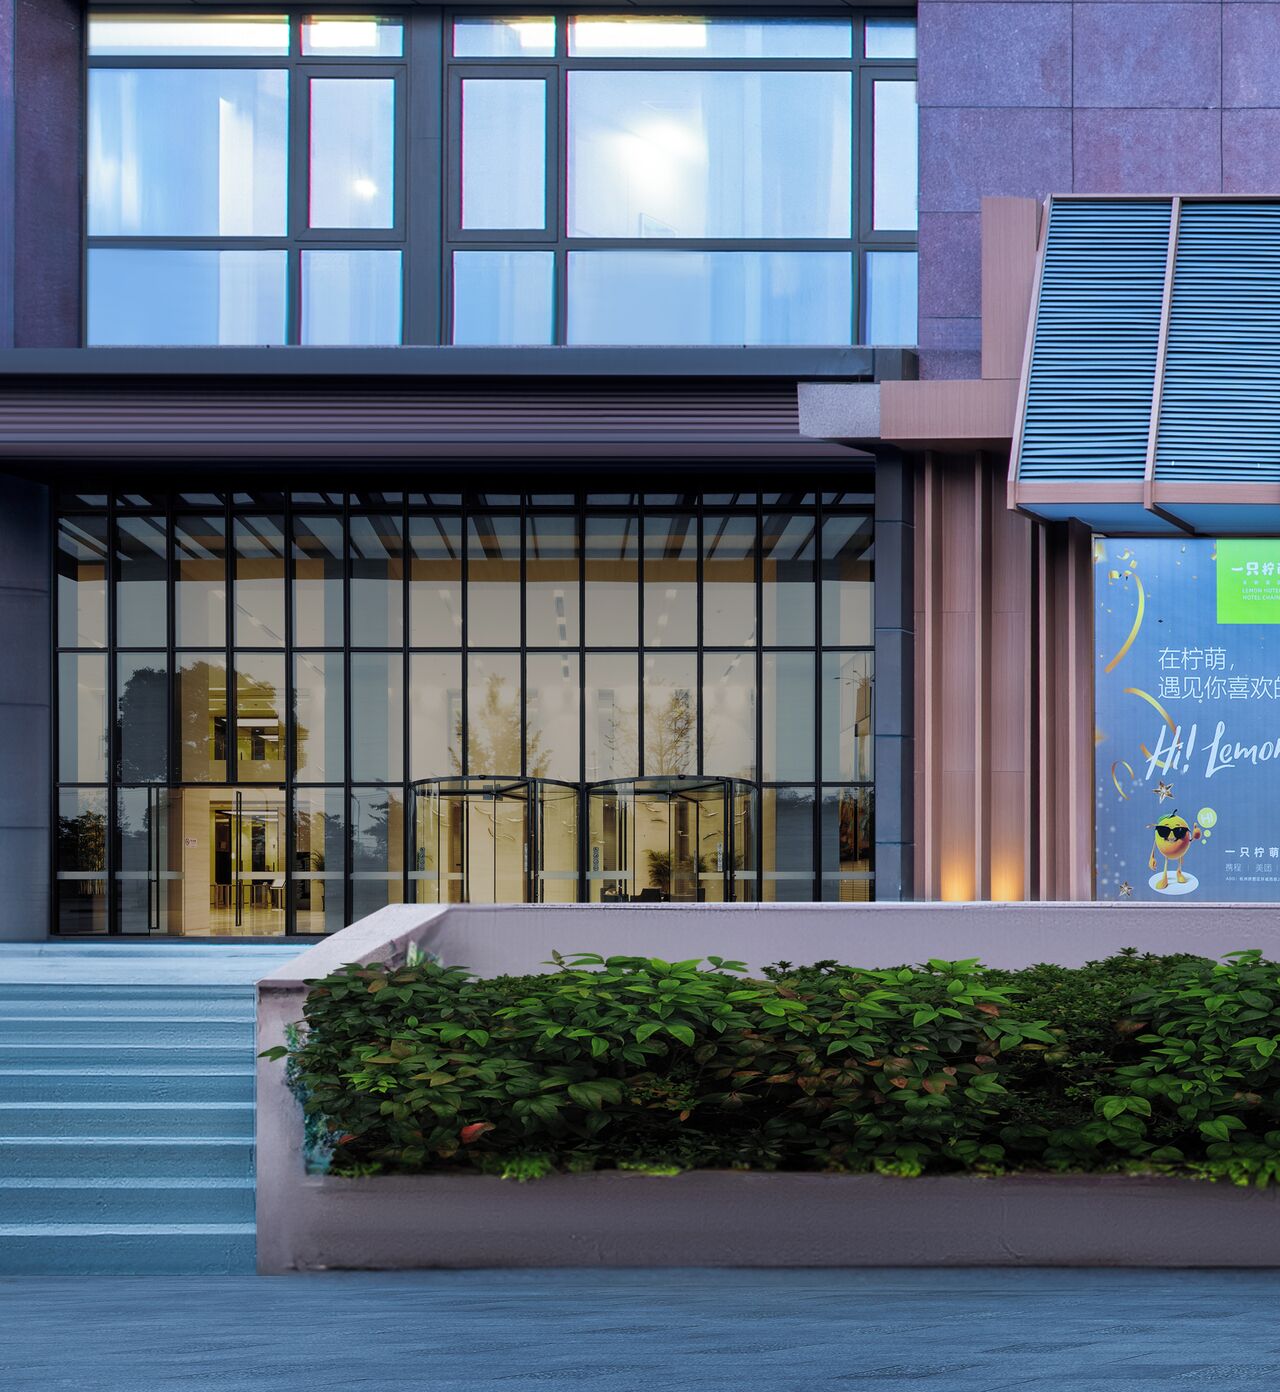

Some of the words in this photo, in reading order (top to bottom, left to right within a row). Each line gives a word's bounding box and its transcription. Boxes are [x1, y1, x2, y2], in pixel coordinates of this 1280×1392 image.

[1157, 646, 1235, 672] 在柠萌，
[1144, 723, 1198, 780] Hi!
